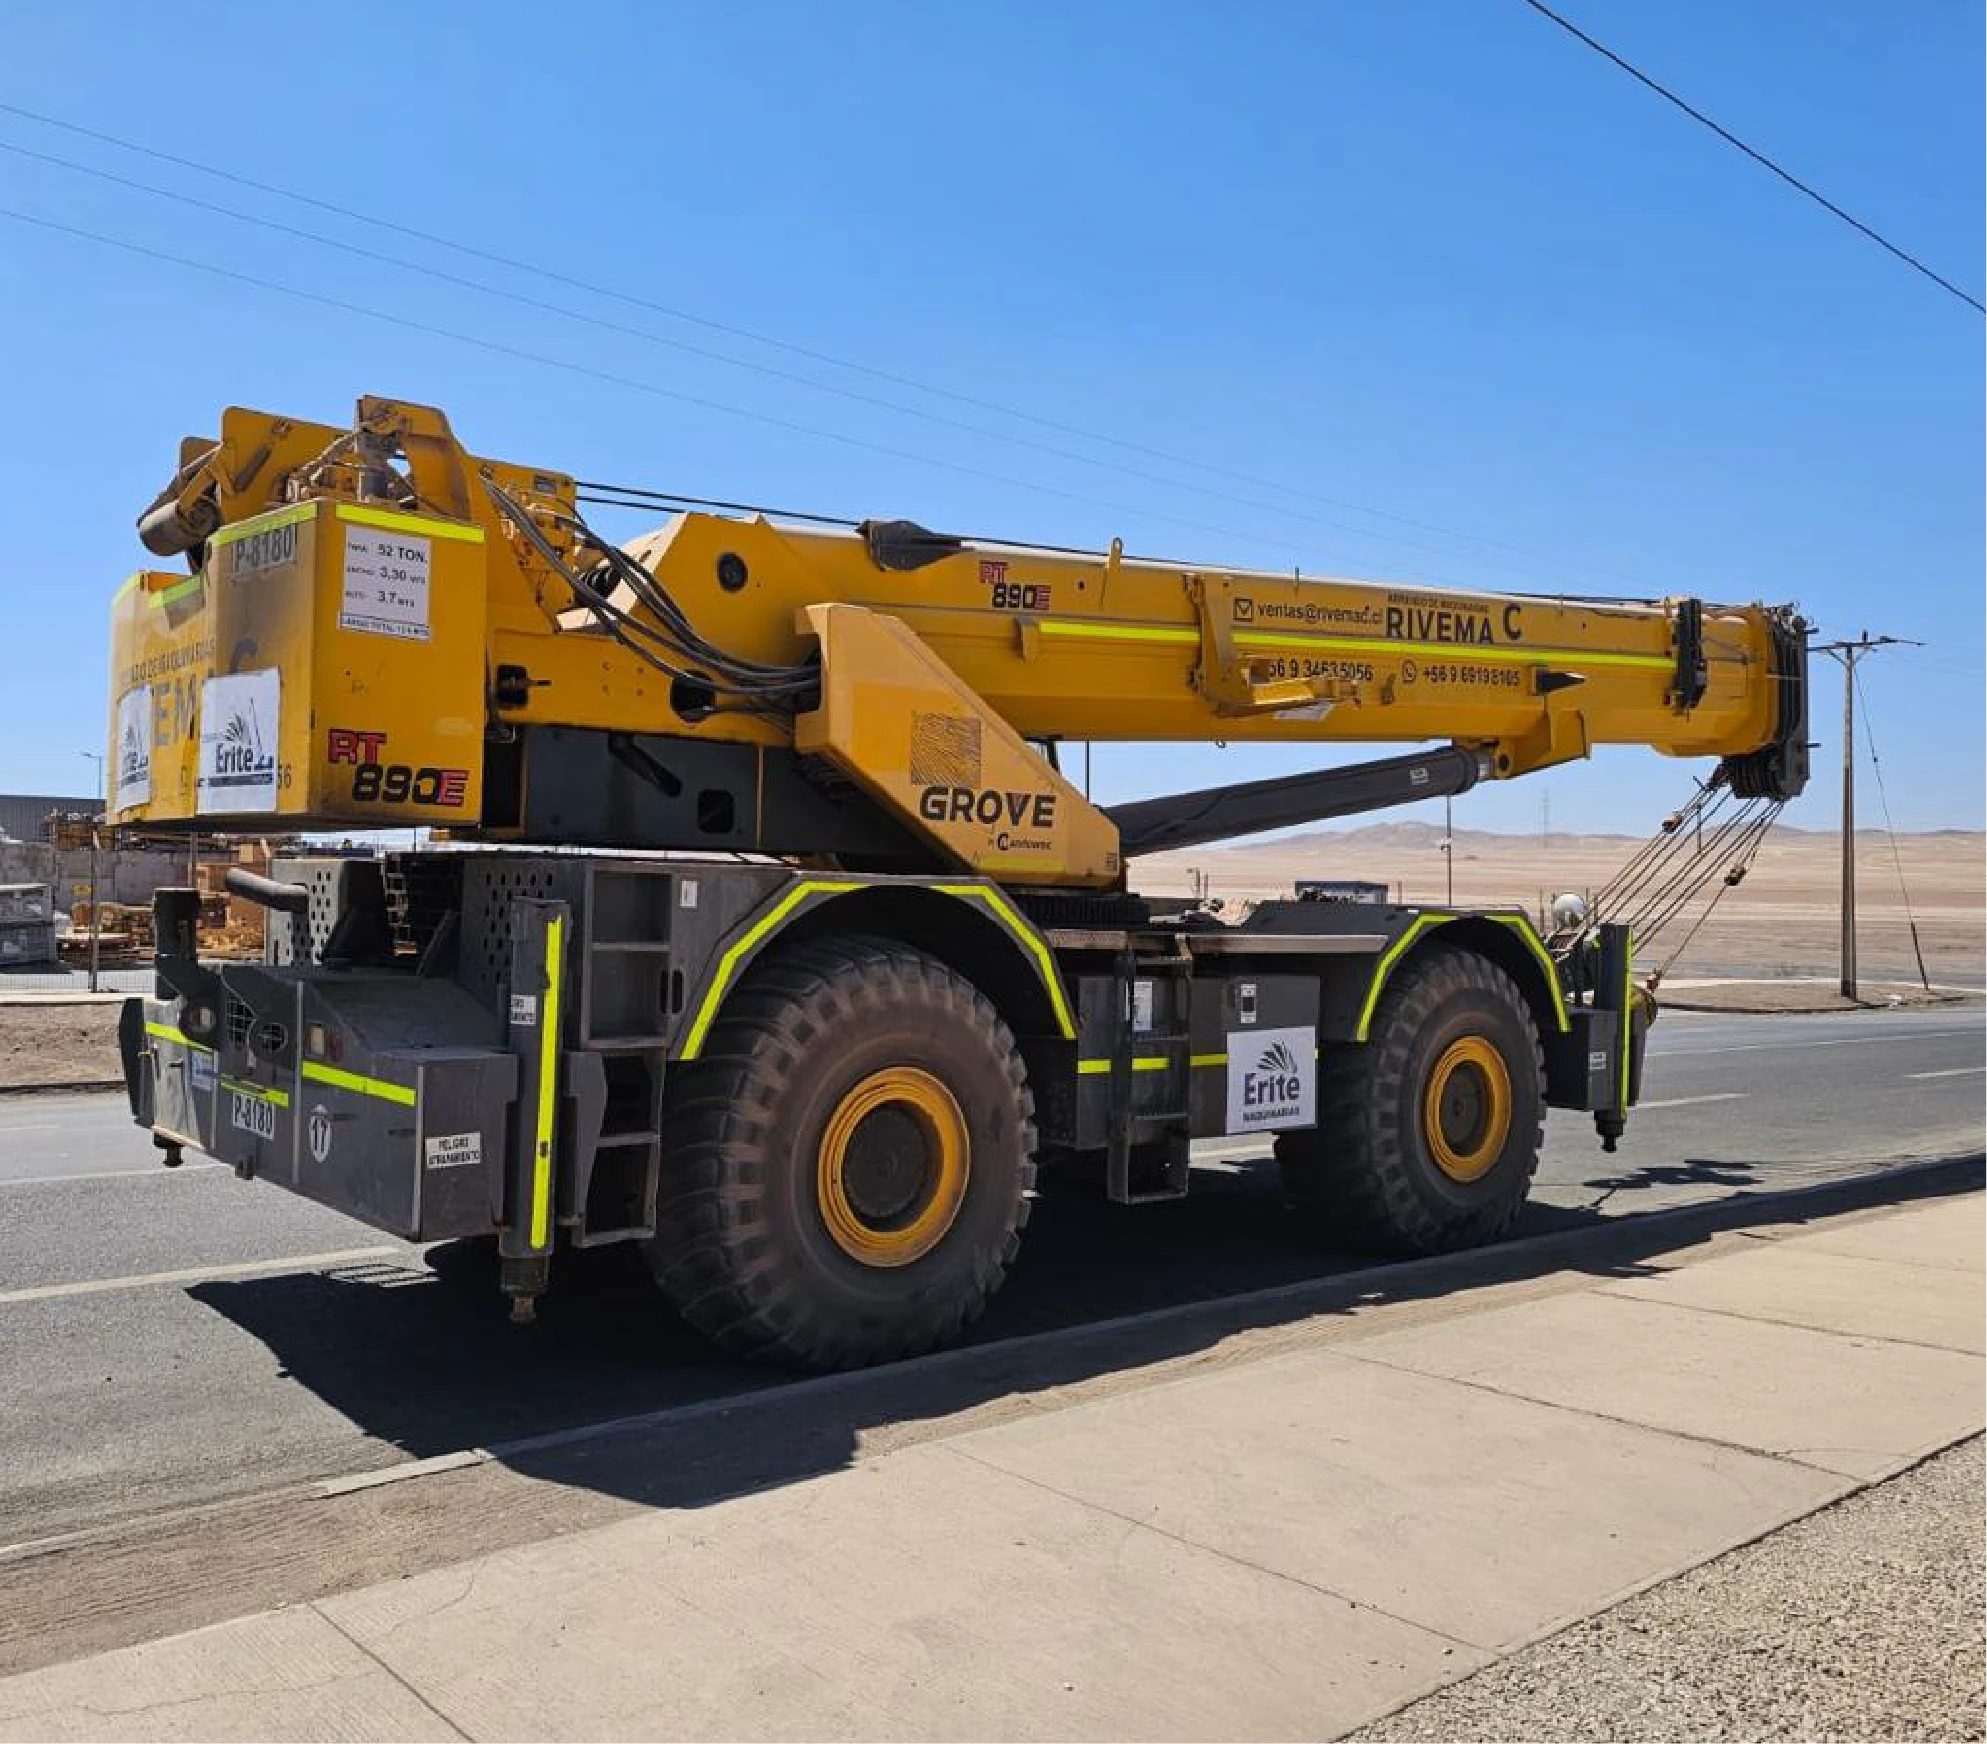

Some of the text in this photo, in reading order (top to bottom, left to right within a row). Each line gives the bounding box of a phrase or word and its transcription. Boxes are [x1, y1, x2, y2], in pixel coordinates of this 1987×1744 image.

[378, 543, 393, 556] 52
[398, 546, 427, 564] TON.
[979, 560, 1008, 584] RT
[992, 583, 1051, 610] 890E
[1386, 607, 1493, 644] RIVEMA
[1290, 658, 1299, 678] 9
[1450, 665, 1457, 683] 9
[327, 728, 387, 765] RT
[353, 764, 469, 808] 890E
[919, 784, 1057, 829] GROVE
[1244, 1072, 1300, 1106] Erite
[234, 1092, 274, 1136] P-8180
[312, 1118, 328, 1151] 17
